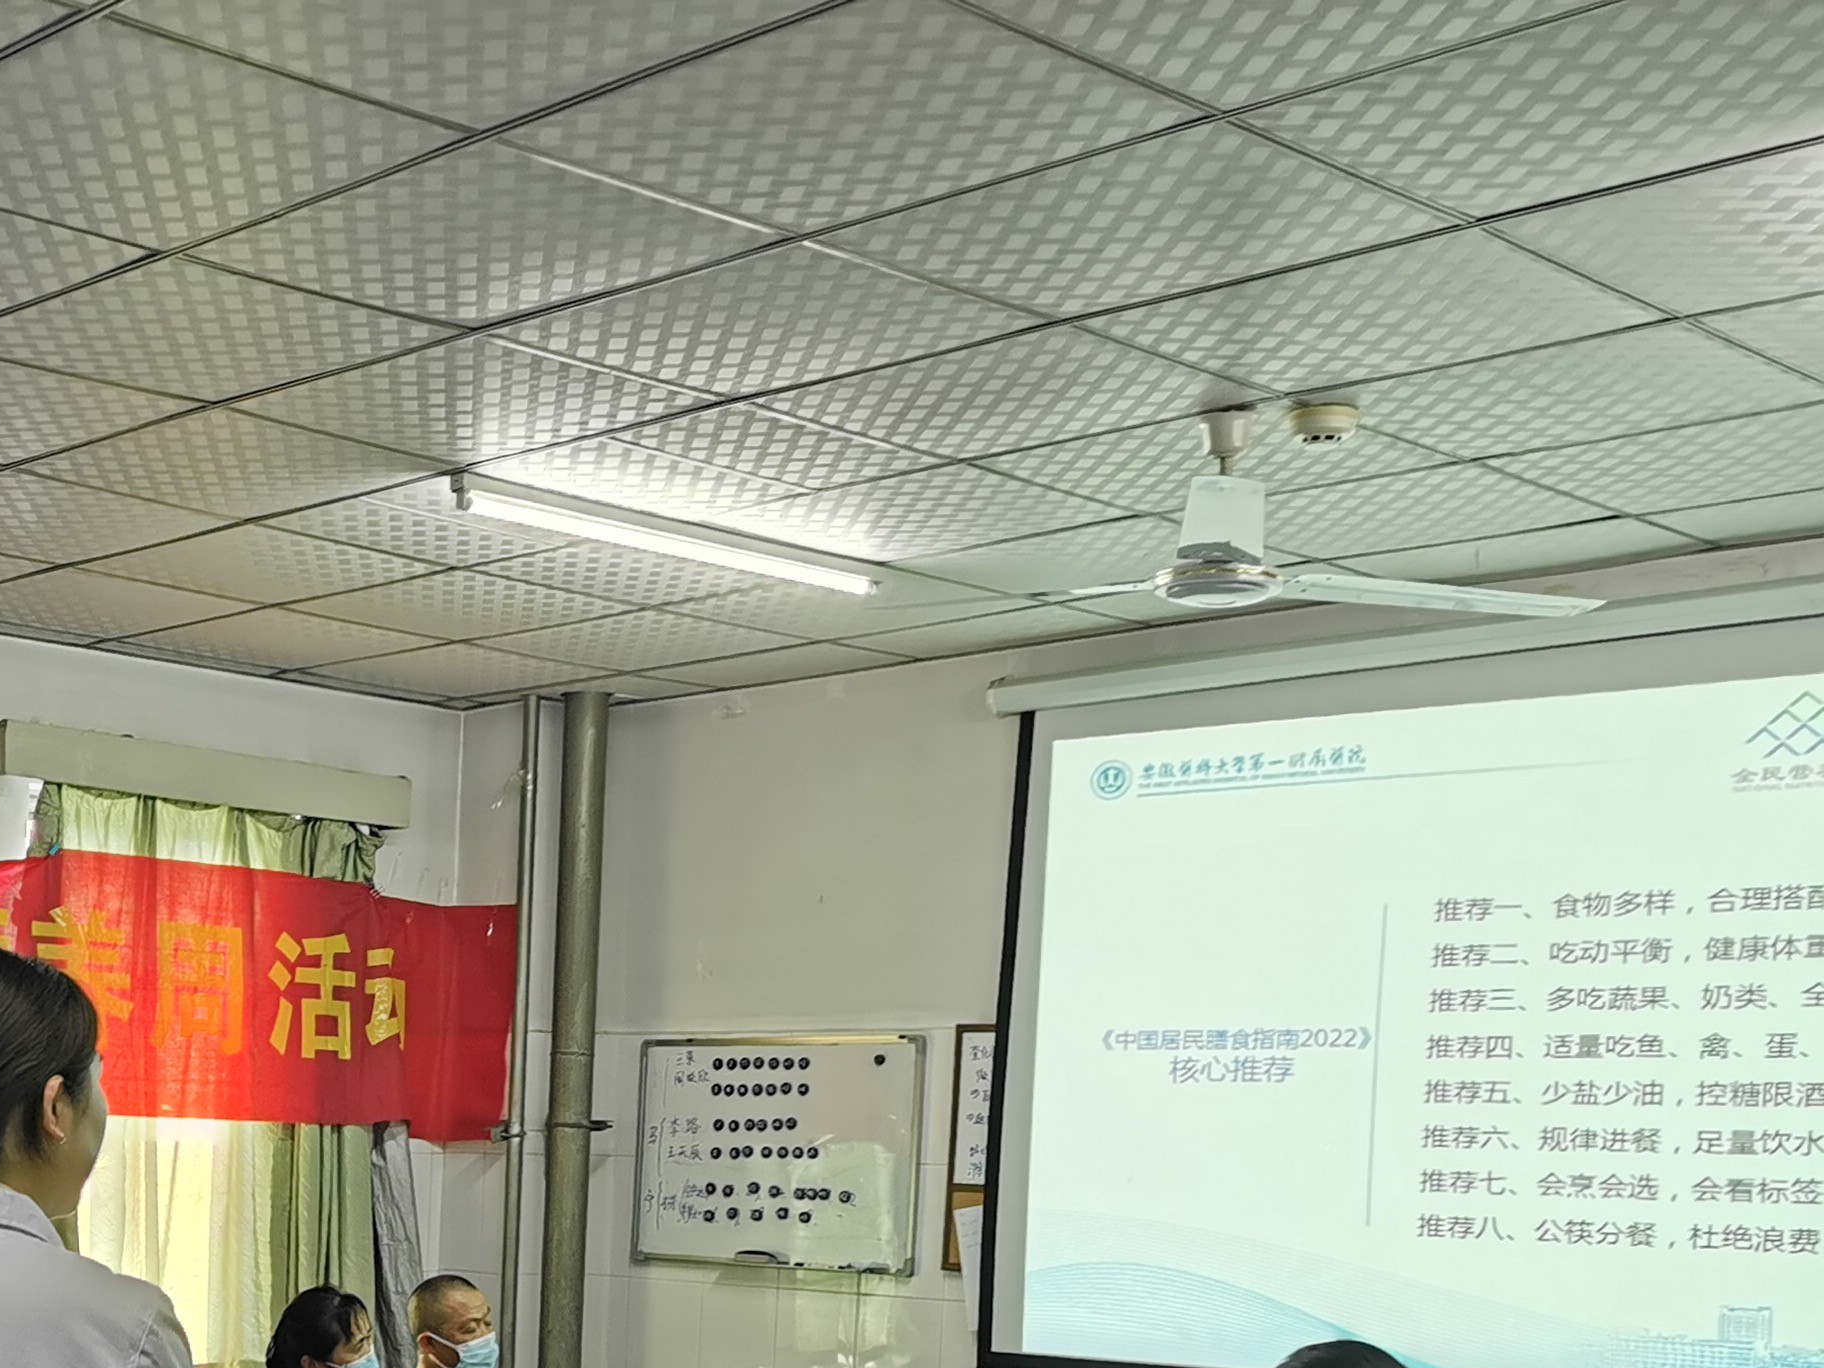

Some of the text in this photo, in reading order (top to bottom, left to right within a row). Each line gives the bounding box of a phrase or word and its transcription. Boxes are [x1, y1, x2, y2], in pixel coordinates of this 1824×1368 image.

[1730, 764, 1824, 784] 全民营
[1100, 1027, 1373, 1052] 《中国居民膳食指南2022》
[1168, 1056, 1296, 1083] 核心推荐
[1416, 1213, 1821, 1255] 推荐八、公筷分餐，杜绝浪费
